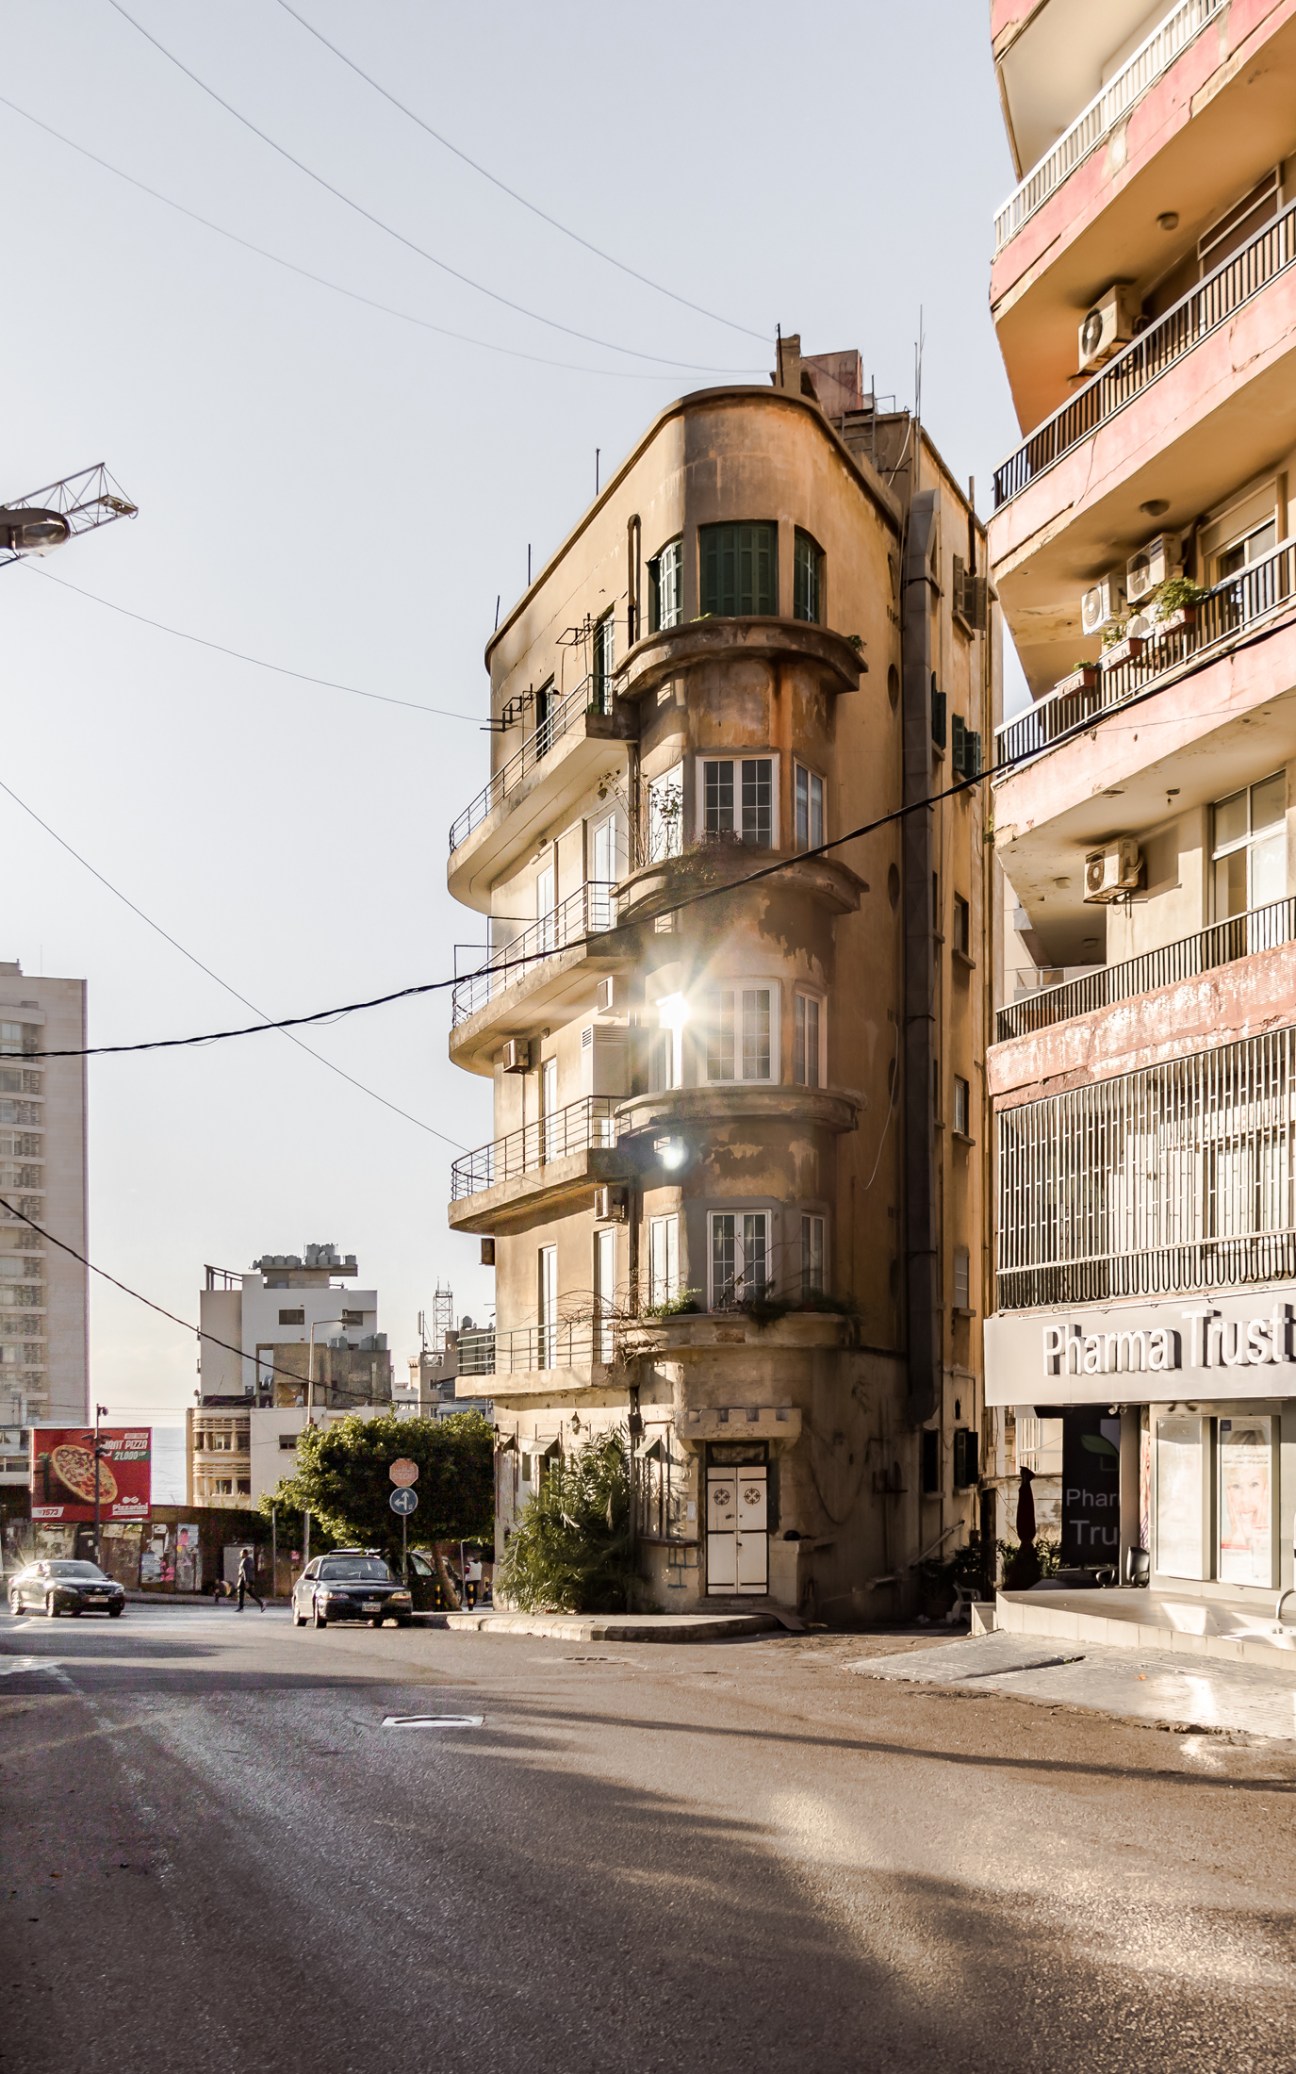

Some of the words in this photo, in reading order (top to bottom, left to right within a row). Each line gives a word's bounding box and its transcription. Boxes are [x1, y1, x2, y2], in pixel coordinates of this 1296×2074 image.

[1042, 1324, 1176, 1377] Pharma
[1181, 1303, 1290, 1368] Trust
[124, 1439, 148, 1450] PIZZA
[1066, 1489, 1120, 1507] Phar
[42, 1508, 59, 1516] 1573
